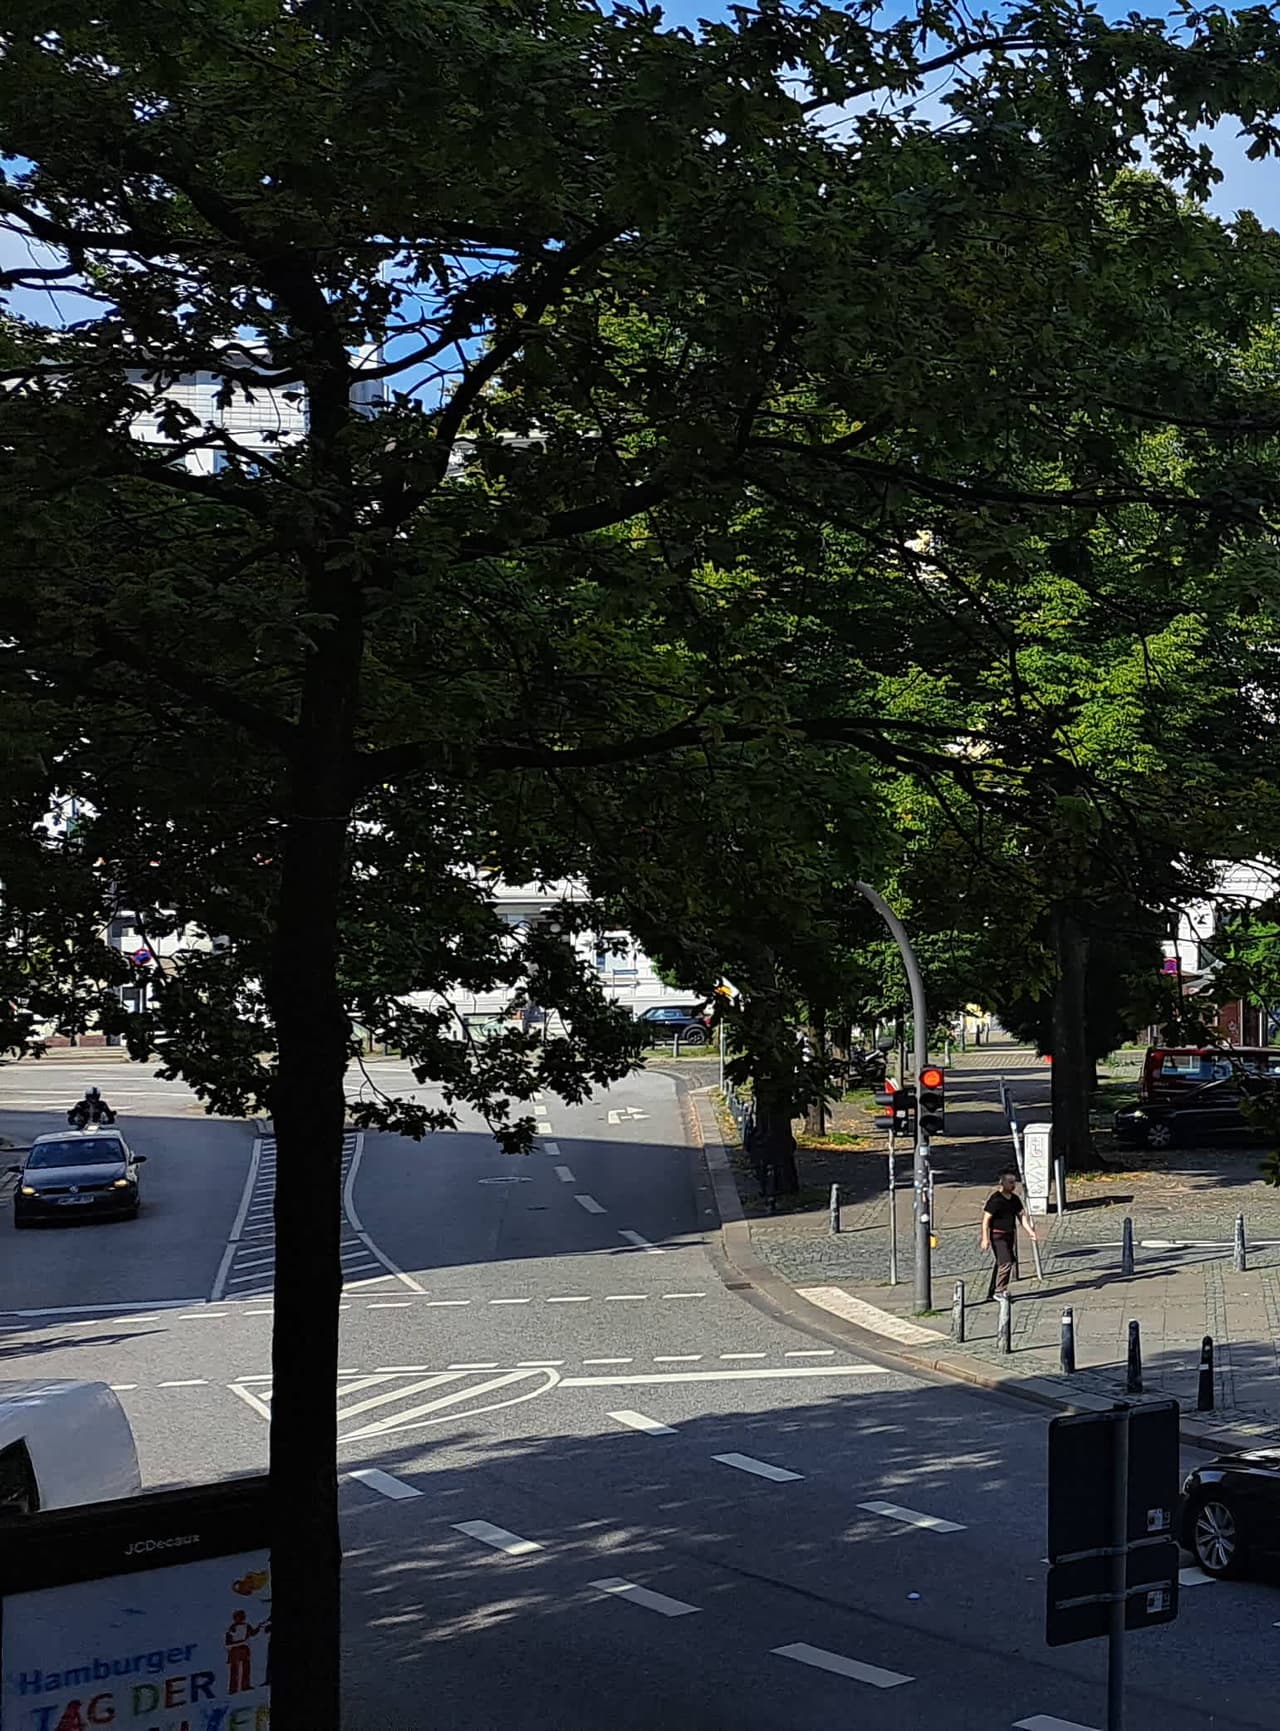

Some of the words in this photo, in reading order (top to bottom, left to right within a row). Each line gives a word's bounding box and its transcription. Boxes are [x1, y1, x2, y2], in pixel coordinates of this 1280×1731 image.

[124, 1534, 201, 1556] JCDecaux
[19, 1643, 199, 1696] Hamburger
[30, 1692, 115, 1731] TAG
[130, 1670, 216, 1717] DER
